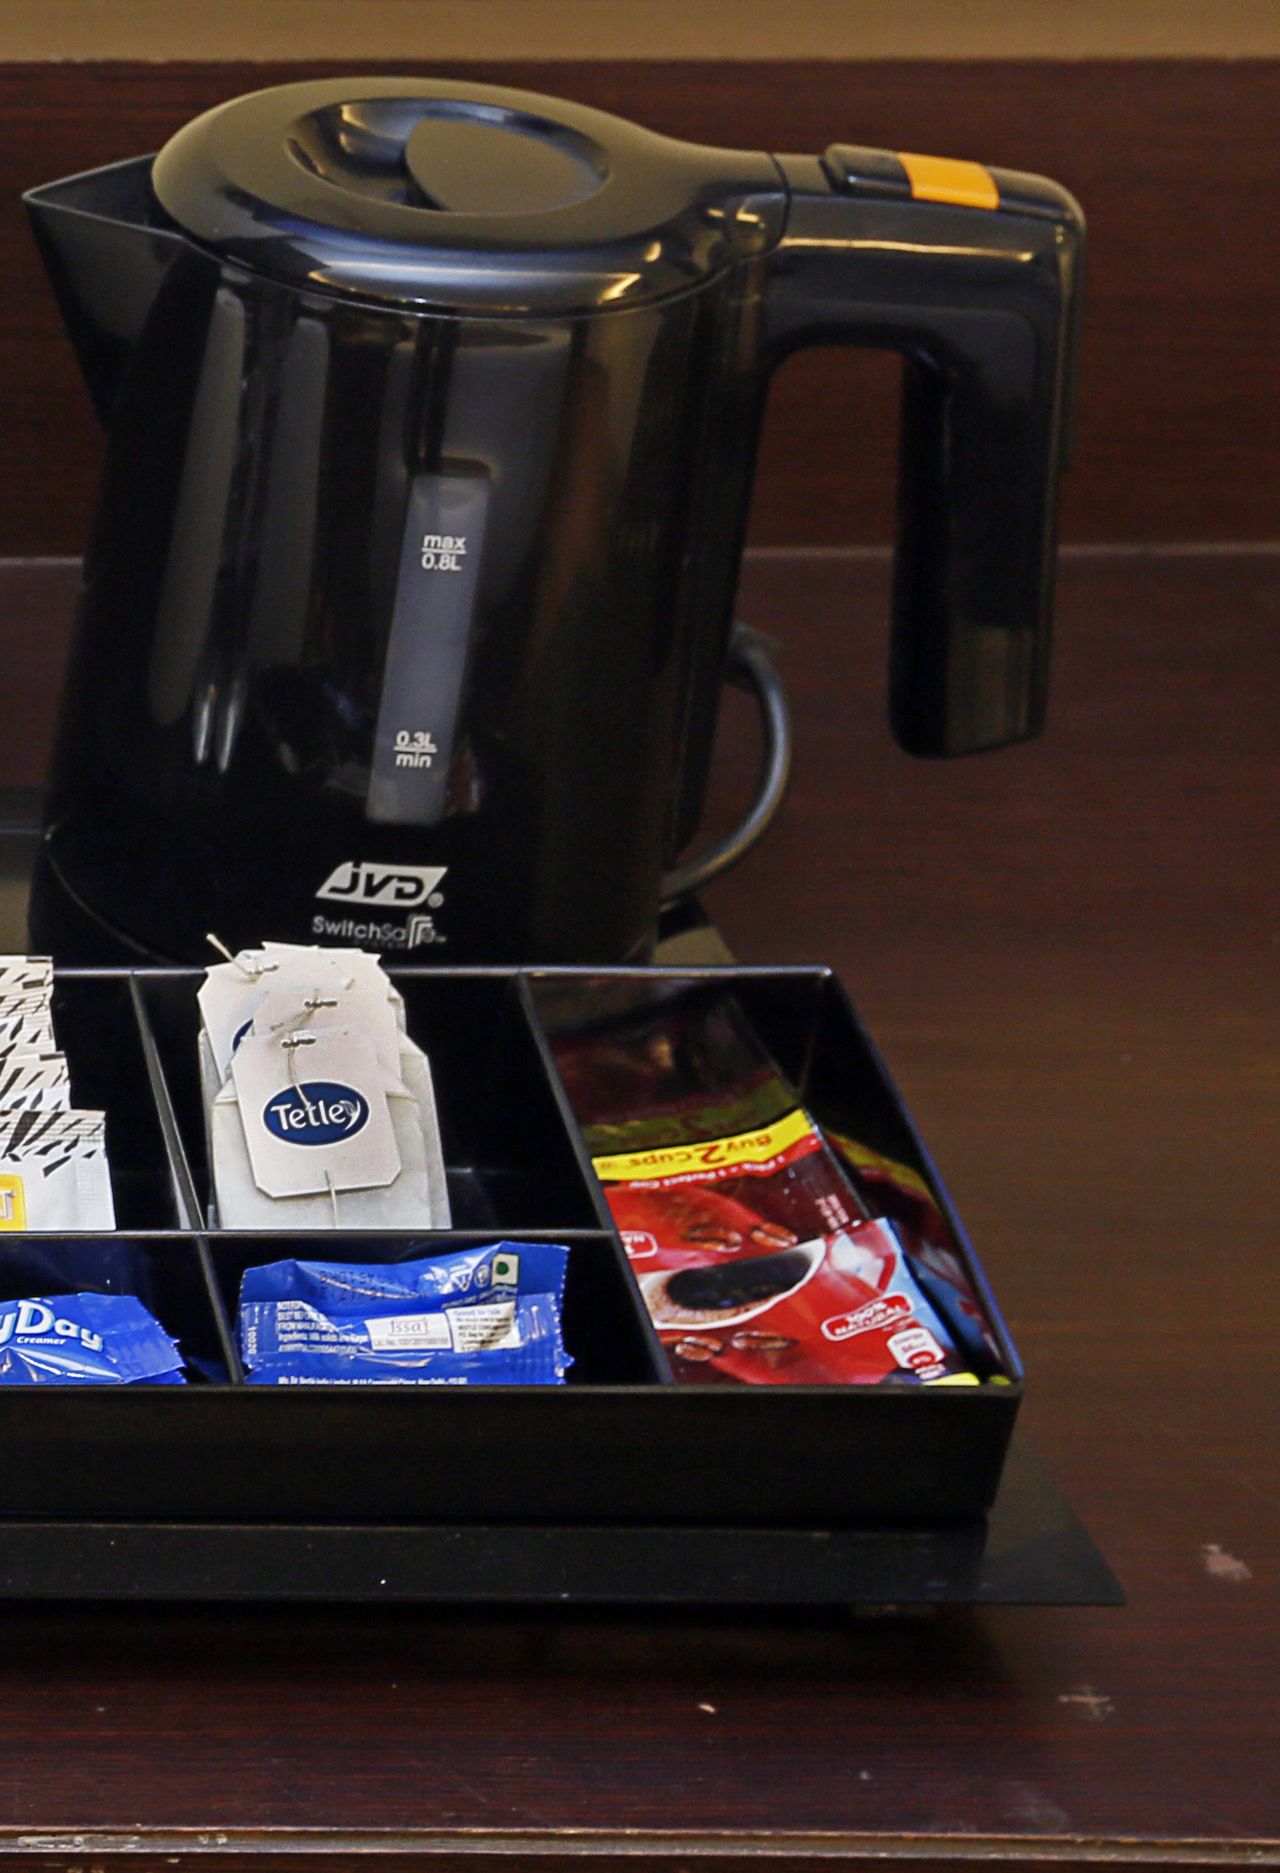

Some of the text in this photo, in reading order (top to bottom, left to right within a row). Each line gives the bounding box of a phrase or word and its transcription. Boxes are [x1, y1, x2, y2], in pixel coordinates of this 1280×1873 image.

[423, 536, 466, 550] max
[421, 553, 462, 571] 0.8L
[396, 731, 434, 747] 0.3L
[395, 752, 432, 768] min
[326, 862, 428, 901] JVD
[270, 1099, 362, 1131] Tetley
[629, 1133, 772, 1167] Buy 2 Cups
[16, 1336, 67, 1347] Creamer
